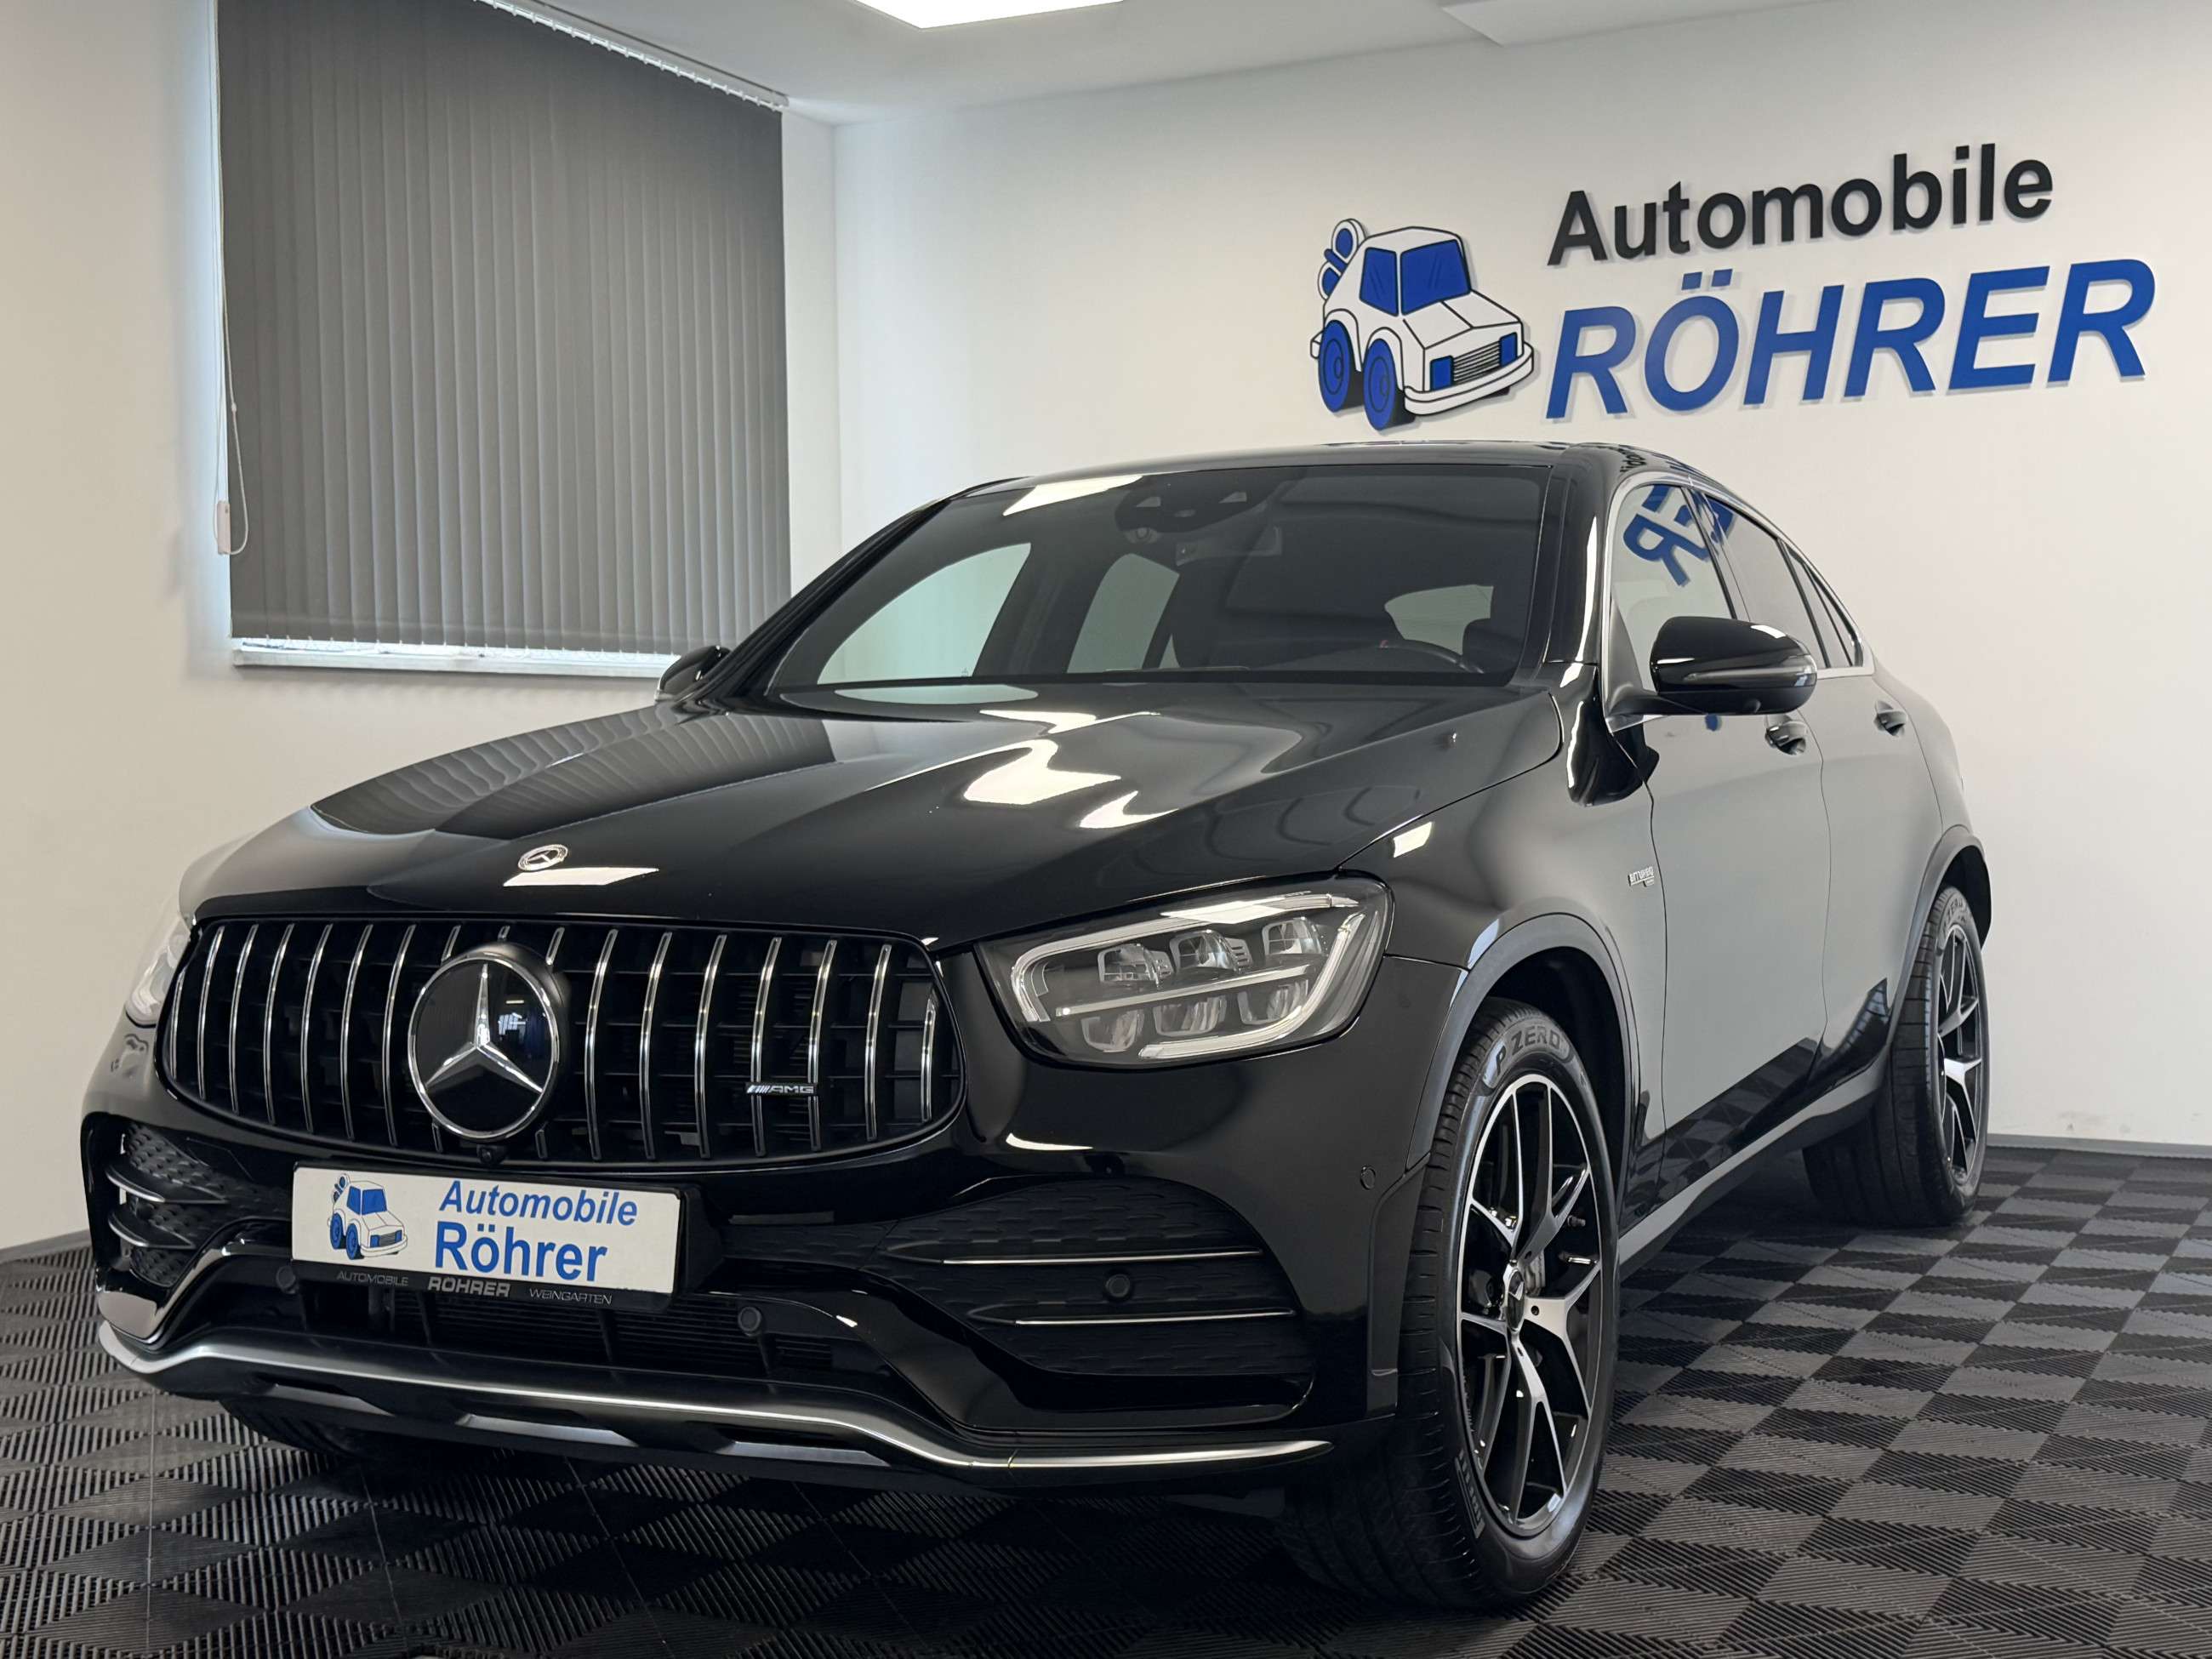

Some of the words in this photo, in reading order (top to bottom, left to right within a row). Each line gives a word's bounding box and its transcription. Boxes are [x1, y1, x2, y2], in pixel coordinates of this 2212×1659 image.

[1548, 143, 2053, 266] Automobile
[1546, 259, 2156, 420] RÖHRER
[1511, 1025, 1560, 1055] ZERO
[767, 1085, 814, 1094] AMG
[440, 1179, 638, 1226] Automobile
[435, 1221, 607, 1282] Röhrer
[337, 1271, 408, 1286] AUTOMOBILE
[529, 1288, 613, 1305] WEINGARTEN
